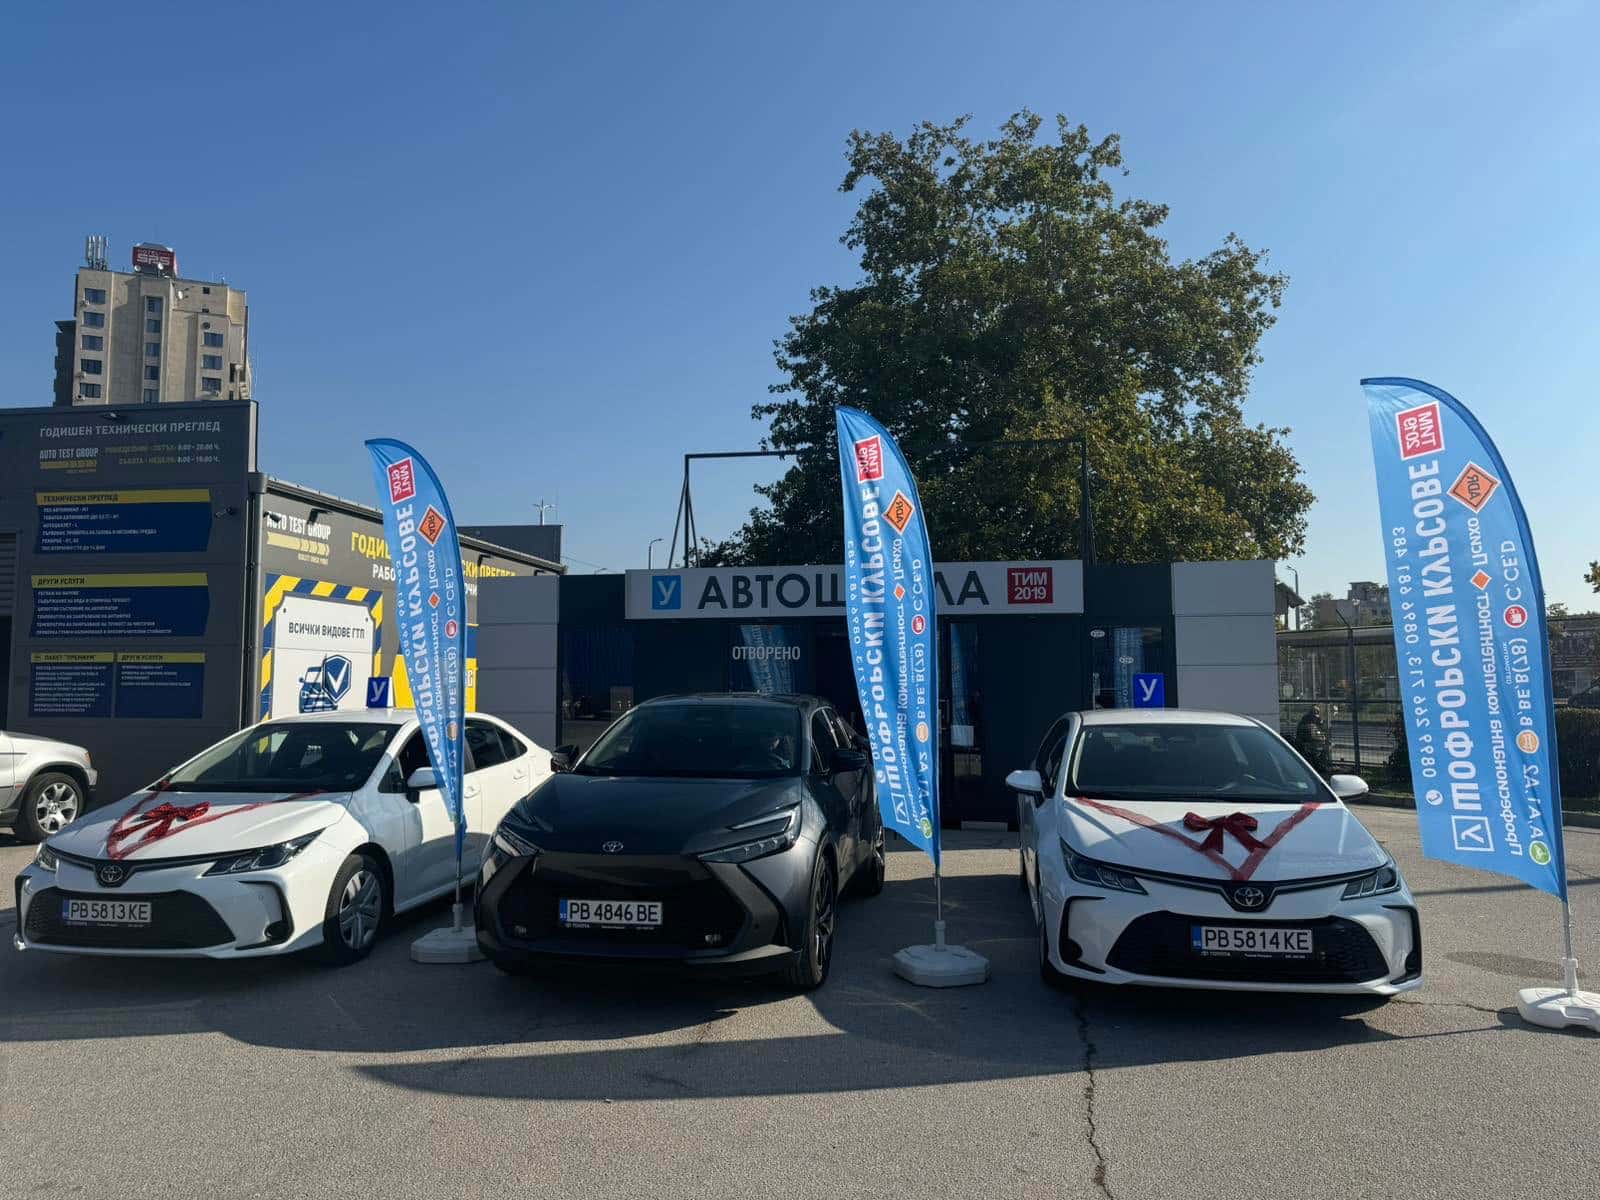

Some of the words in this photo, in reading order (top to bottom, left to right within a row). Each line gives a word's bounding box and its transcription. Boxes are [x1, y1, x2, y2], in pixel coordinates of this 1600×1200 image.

[39, 425, 93, 439] ГОДИШЕН
[96, 422, 167, 436] ТЕХНИЧЕСКИ
[169, 420, 221, 434] ПРЕГЛЕД
[39, 449, 56, 459] AUTO
[57, 448, 75, 458] TEST
[76, 447, 98, 457] GROUP
[288, 515, 307, 536] TEST
[1011, 572, 1047, 587] ТИМ
[656, 581, 676, 606] У
[697, 570, 989, 609] АВТОШЛА
[1013, 586, 1047, 601] 2019
[289, 622, 320, 636] ВСИЧКИ
[322, 625, 351, 639] ВИДОВЕ
[352, 628, 365, 639] ГТП
[732, 646, 801, 660] ОТВОРЕНО
[370, 680, 387, 702] У
[1138, 678, 1158, 702] У
[70, 902, 88, 918] PB
[91, 903, 126, 920] 5813
[128, 904, 148, 921] KE
[569, 902, 591, 920] PB
[593, 903, 633, 921] 4846
[637, 904, 658, 922] BE
[1205, 929, 1229, 948] PB
[1234, 930, 1280, 950] 5814
[1284, 931, 1309, 950] KE
